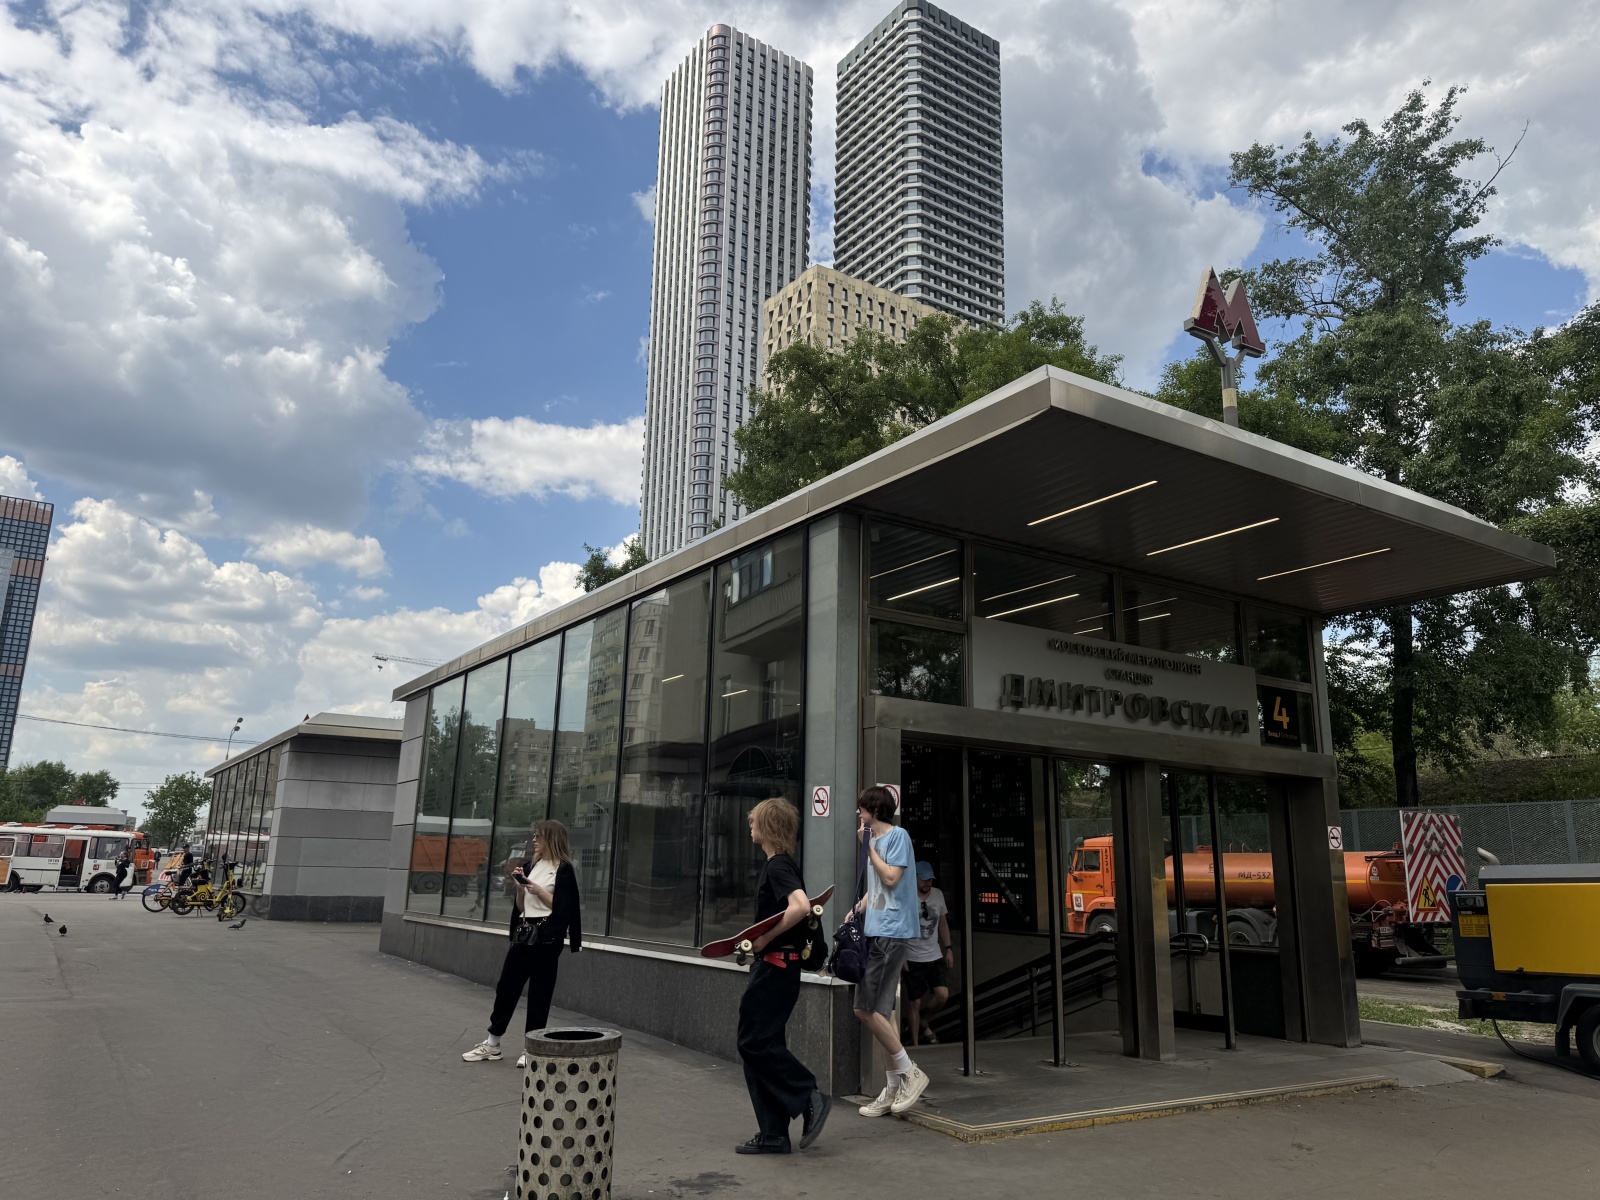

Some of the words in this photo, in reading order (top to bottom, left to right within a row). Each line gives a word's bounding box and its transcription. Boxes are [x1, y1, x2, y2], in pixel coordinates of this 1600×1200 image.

[1050, 640, 1127, 662] МОСКОВСКИЙ
[1128, 653, 1202, 674] МЕТРОПОЛИТЕН
[1105, 668, 1154, 686] СТАНЦИЯ
[1001, 674, 1249, 734] ДМИТРОВСКАЯ
[1273, 696, 1290, 729] 4
